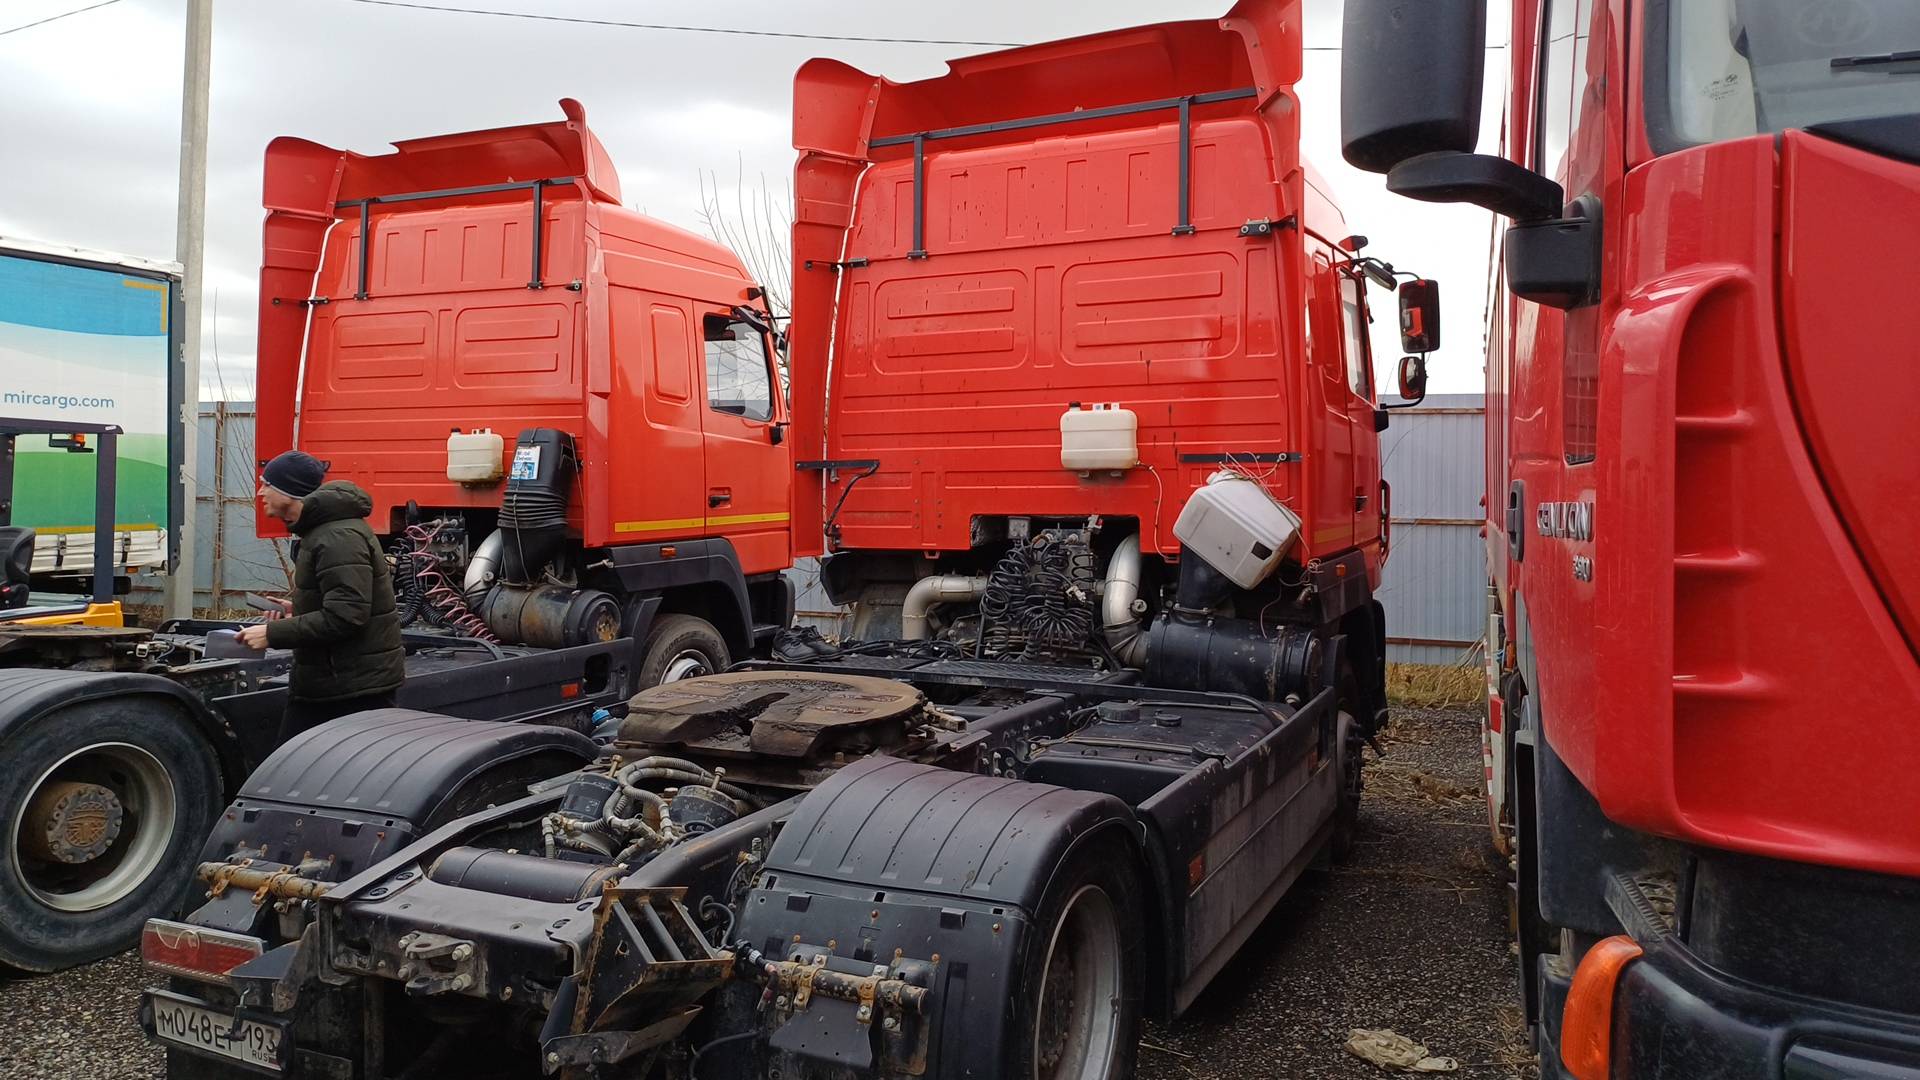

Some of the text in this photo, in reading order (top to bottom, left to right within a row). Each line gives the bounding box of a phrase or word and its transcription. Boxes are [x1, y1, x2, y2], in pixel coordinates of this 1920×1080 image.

[4, 390, 115, 409] mircargo.com
[244, 1023, 278, 1054] 193
[251, 1049, 269, 1063] RUS
